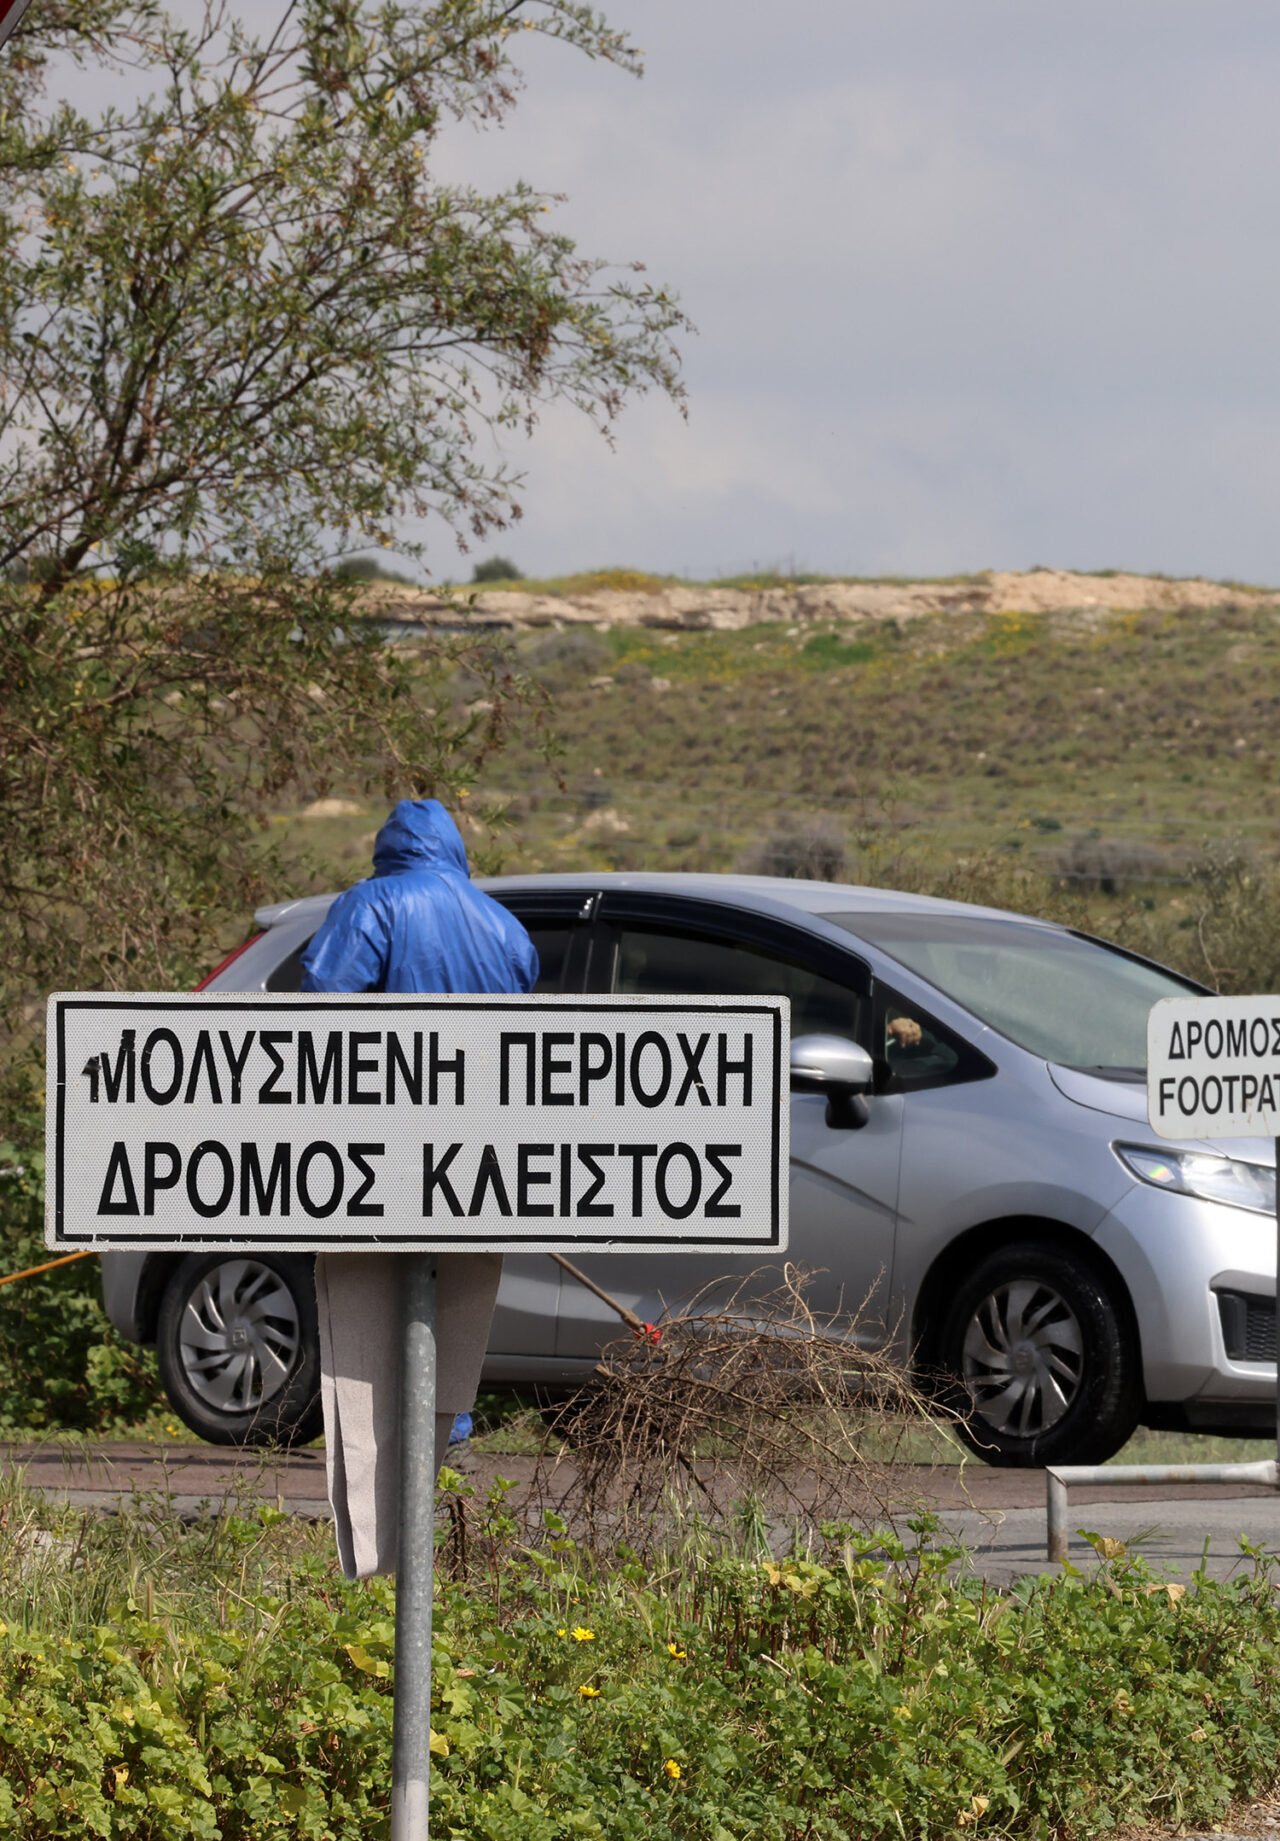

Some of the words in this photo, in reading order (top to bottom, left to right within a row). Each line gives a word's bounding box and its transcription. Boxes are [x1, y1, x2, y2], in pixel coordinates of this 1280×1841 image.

[82, 1028, 466, 1106] ΜΟΛΥΣΜΕΝΗ
[499, 1031, 754, 1108] ΠΕΡΙΟΧΗ
[97, 1140, 386, 1219] ΔΡΟΜΟΣ
[422, 1141, 743, 1220] ΚΛΕΙΣΤΟΣ
